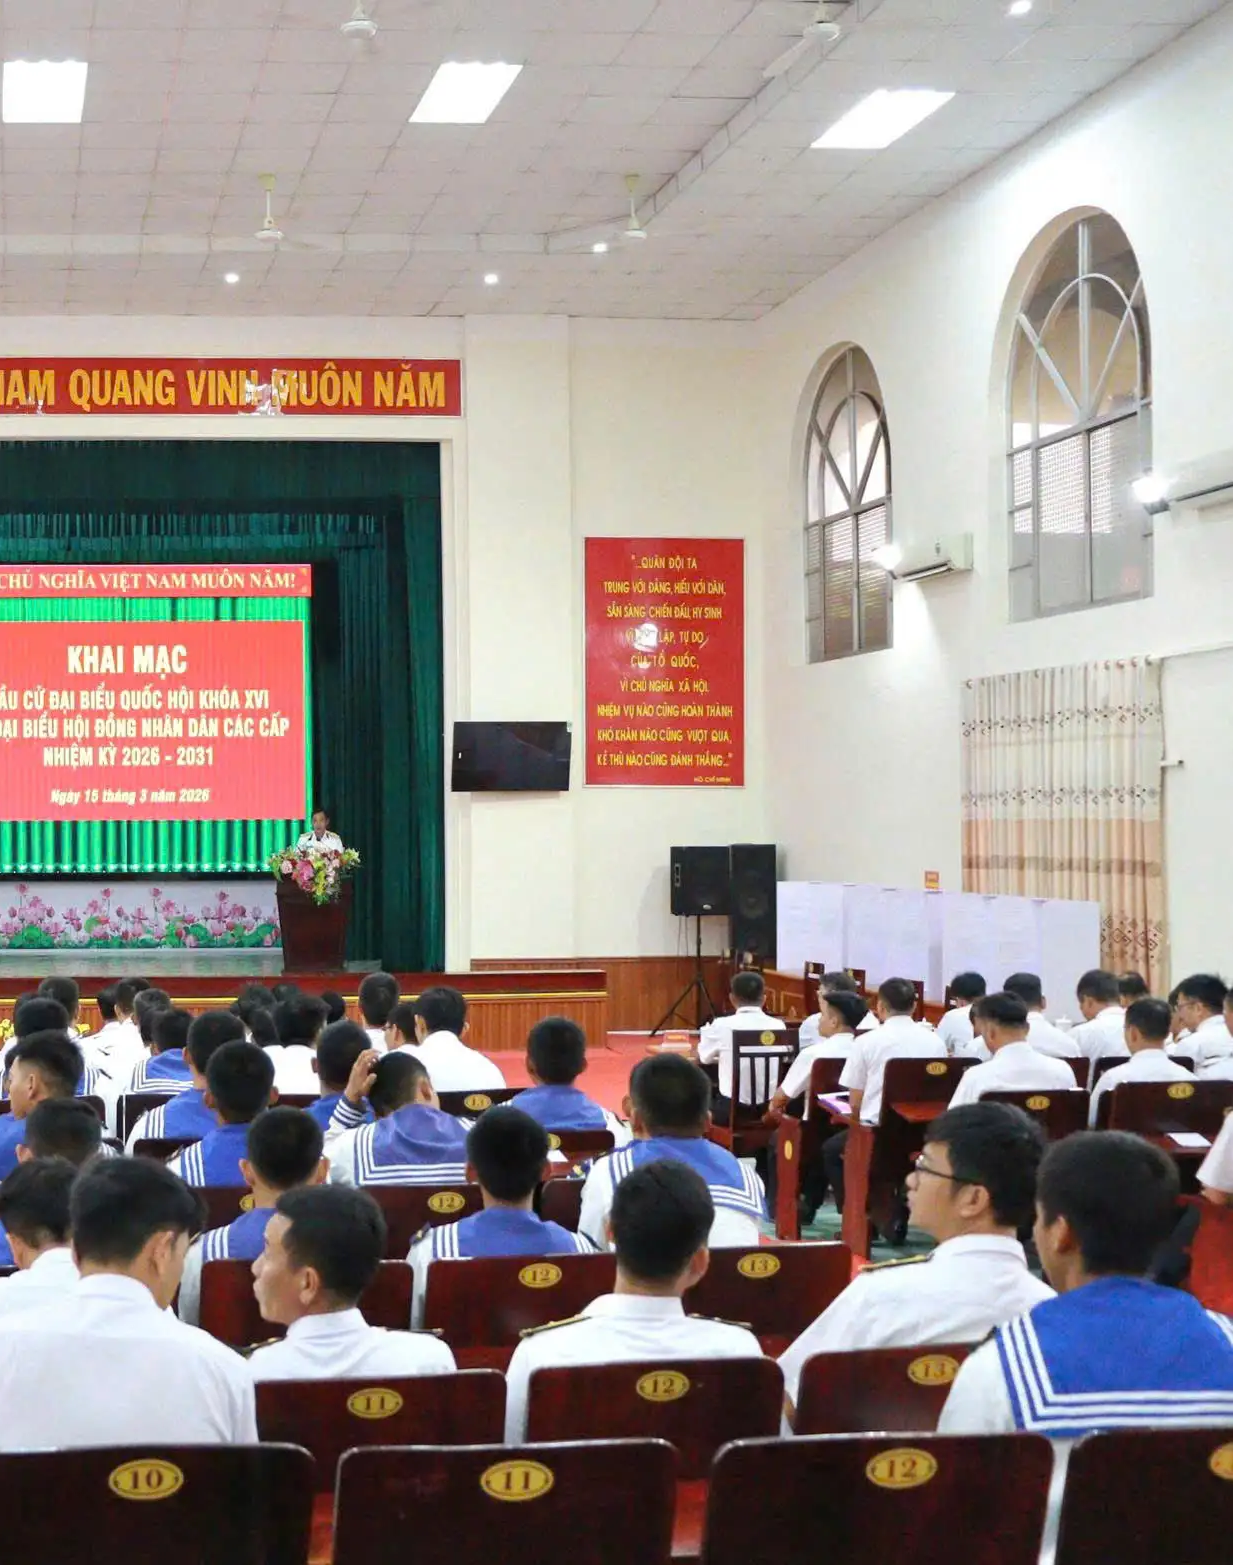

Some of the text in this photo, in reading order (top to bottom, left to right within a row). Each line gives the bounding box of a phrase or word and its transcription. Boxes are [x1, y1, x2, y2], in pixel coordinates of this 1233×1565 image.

[69, 368, 176, 412] QUANG
[186, 369, 259, 407] VINH
[271, 361, 362, 407] MUÔN
[373, 363, 446, 407] NĂM
[687, 557, 698, 570] TA
[38, 570, 97, 589] NGHĨA
[100, 571, 142, 593] VIỆT
[146, 573, 186, 588] NAM
[191, 568, 245, 588] MUÔN
[250, 569, 296, 588] NĂM!
[604, 581, 630, 595] TRUNG
[704, 606, 723, 619] SINH
[67, 645, 187, 680] KHAI MẠC
[23, 684, 46, 710] CỬ
[49, 690, 75, 714] ĐẠI
[80, 681, 115, 710] BIỂU
[120, 683, 162, 712] QUỐC
[167, 685, 194, 713] HỘI
[199, 685, 240, 709] KHÓA
[244, 689, 269, 709] XVI
[22, 711, 58, 738] BIỂU
[63, 714, 90, 743] HỘI
[94, 712, 137, 738] ĐỒNG
[141, 713, 183, 738] NHÂN
[188, 713, 218, 737] DÂN
[223, 714, 255, 737] CÁC
[259, 711, 290, 737] CẤP
[43, 743, 94, 769] NHIỆM
[98, 742, 118, 767] KỲ
[121, 746, 160, 767] 2026
[176, 746, 214, 767] 2031
[50, 788, 81, 806] Ngày
[84, 789, 99, 803] 15
[102, 788, 136, 806] tháng
[150, 789, 176, 803] năm
[179, 788, 210, 803] 2026
[531, 1268, 551, 1282] 12
[653, 1378, 675, 1394] 12
[363, 1394, 386, 1411] 11
[130, 1468, 164, 1490] 10
[501, 1468, 532, 1490] 11
[886, 1458, 918, 1479] 12
